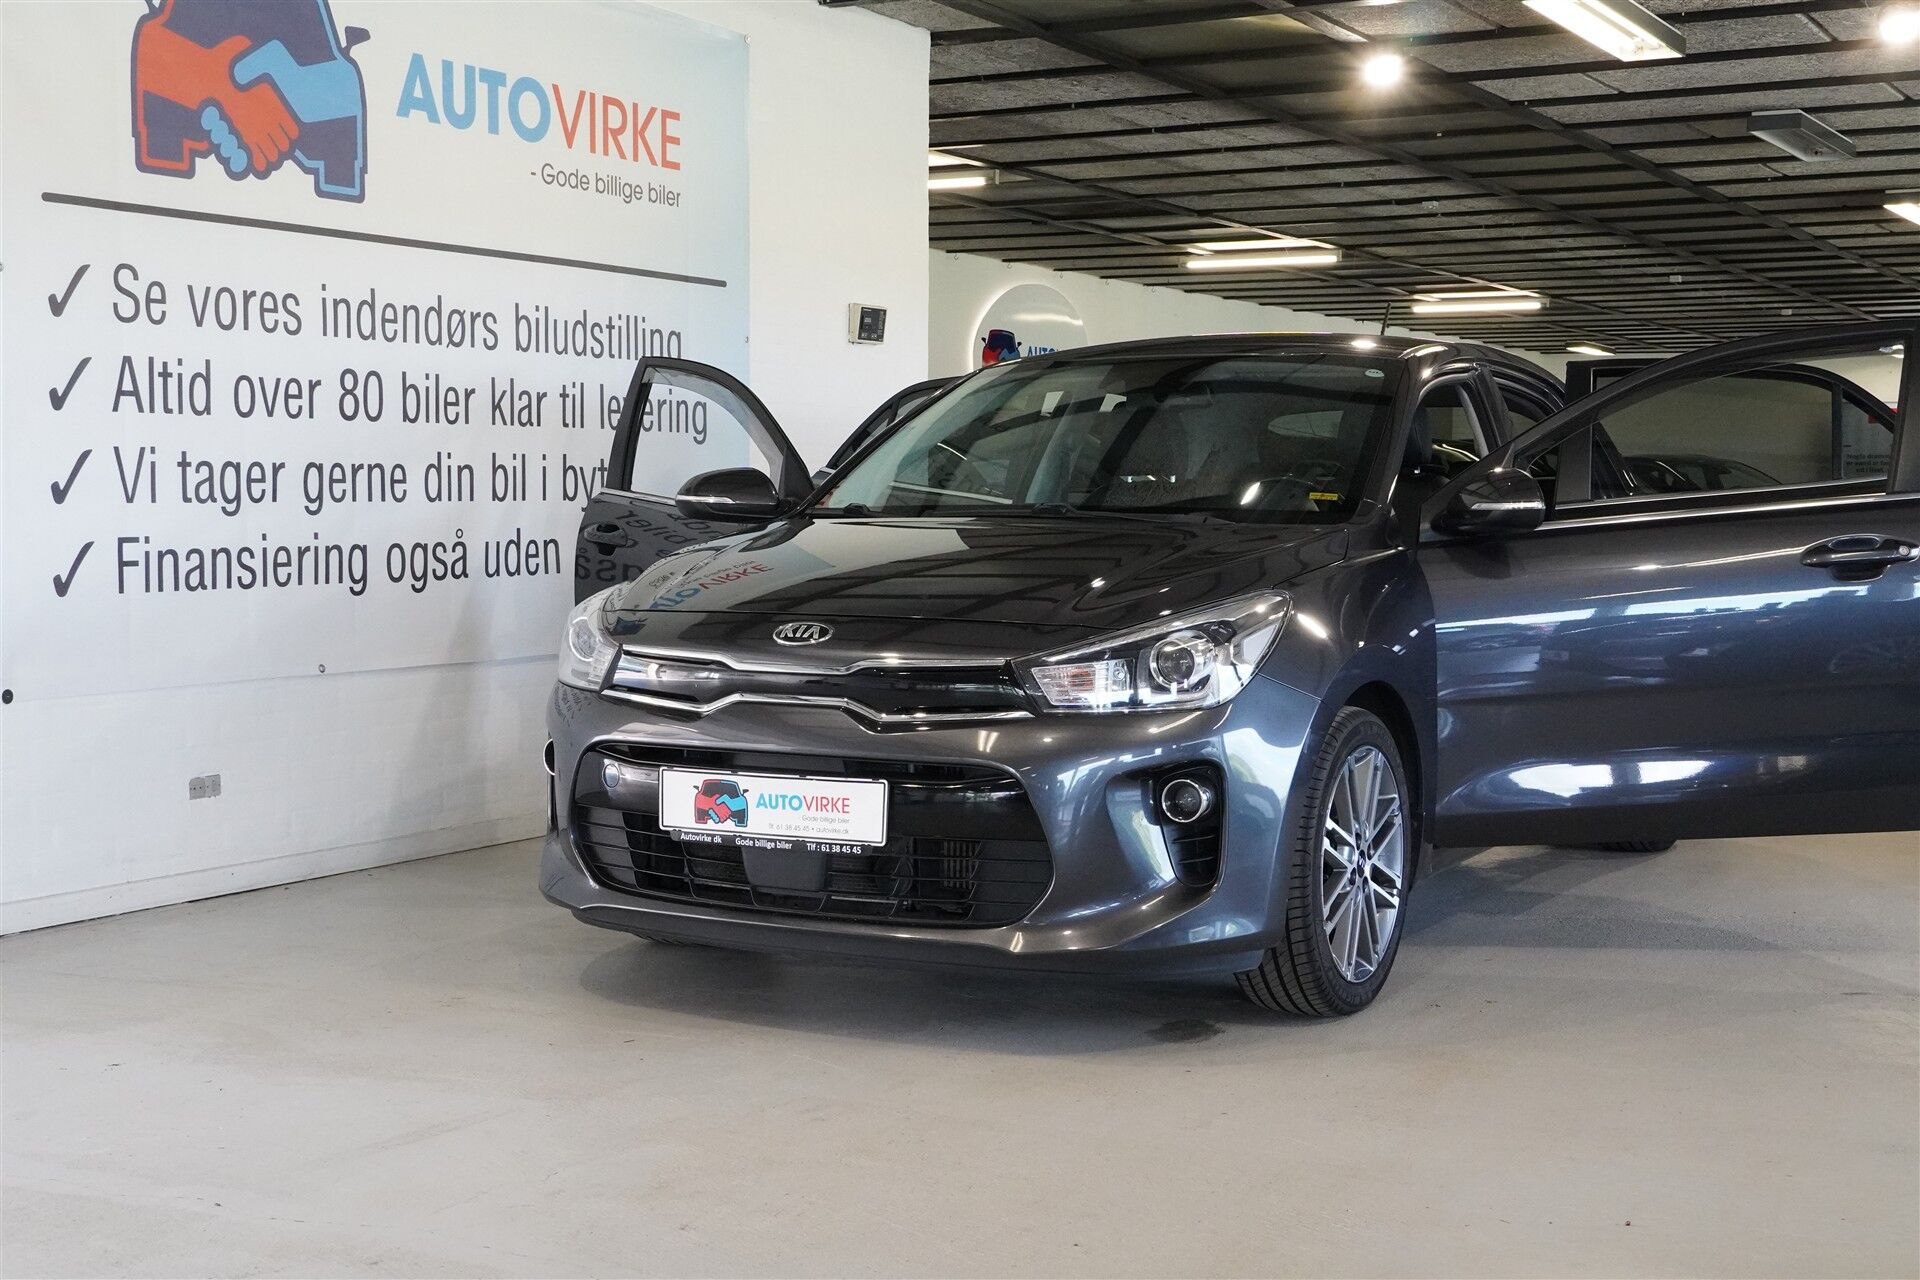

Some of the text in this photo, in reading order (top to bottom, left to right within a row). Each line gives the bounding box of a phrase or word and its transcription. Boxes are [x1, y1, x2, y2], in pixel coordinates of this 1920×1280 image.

[396, 53, 681, 171] AUTOVIRKE
[541, 163, 590, 191] Gode
[595, 172, 643, 204] billige
[648, 182, 681, 207] biler
[113, 263, 682, 361] Se vores indendørs biludstilling
[112, 355, 707, 445] Altid over 80 biler klar til leering
[113, 446, 157, 504] Vi
[177, 451, 286, 517] tager
[303, 461, 407, 515] gerne
[424, 451, 475, 503] din
[492, 452, 526, 502] bil
[541, 453, 547, 502] i
[117, 527, 561, 596] Finansiering også uden
[779, 624, 821, 640] KIA
[756, 792, 850, 814] AUTOVIRKE
[802, 814, 818, 822] Gode
[819, 816, 836, 824] billige
[735, 837, 792, 849] Gode billige biler
[821, 844, 830, 852] 61
[831, 844, 841, 853] 38
[841, 845, 851, 854] 45
[851, 845, 862, 855] 45
